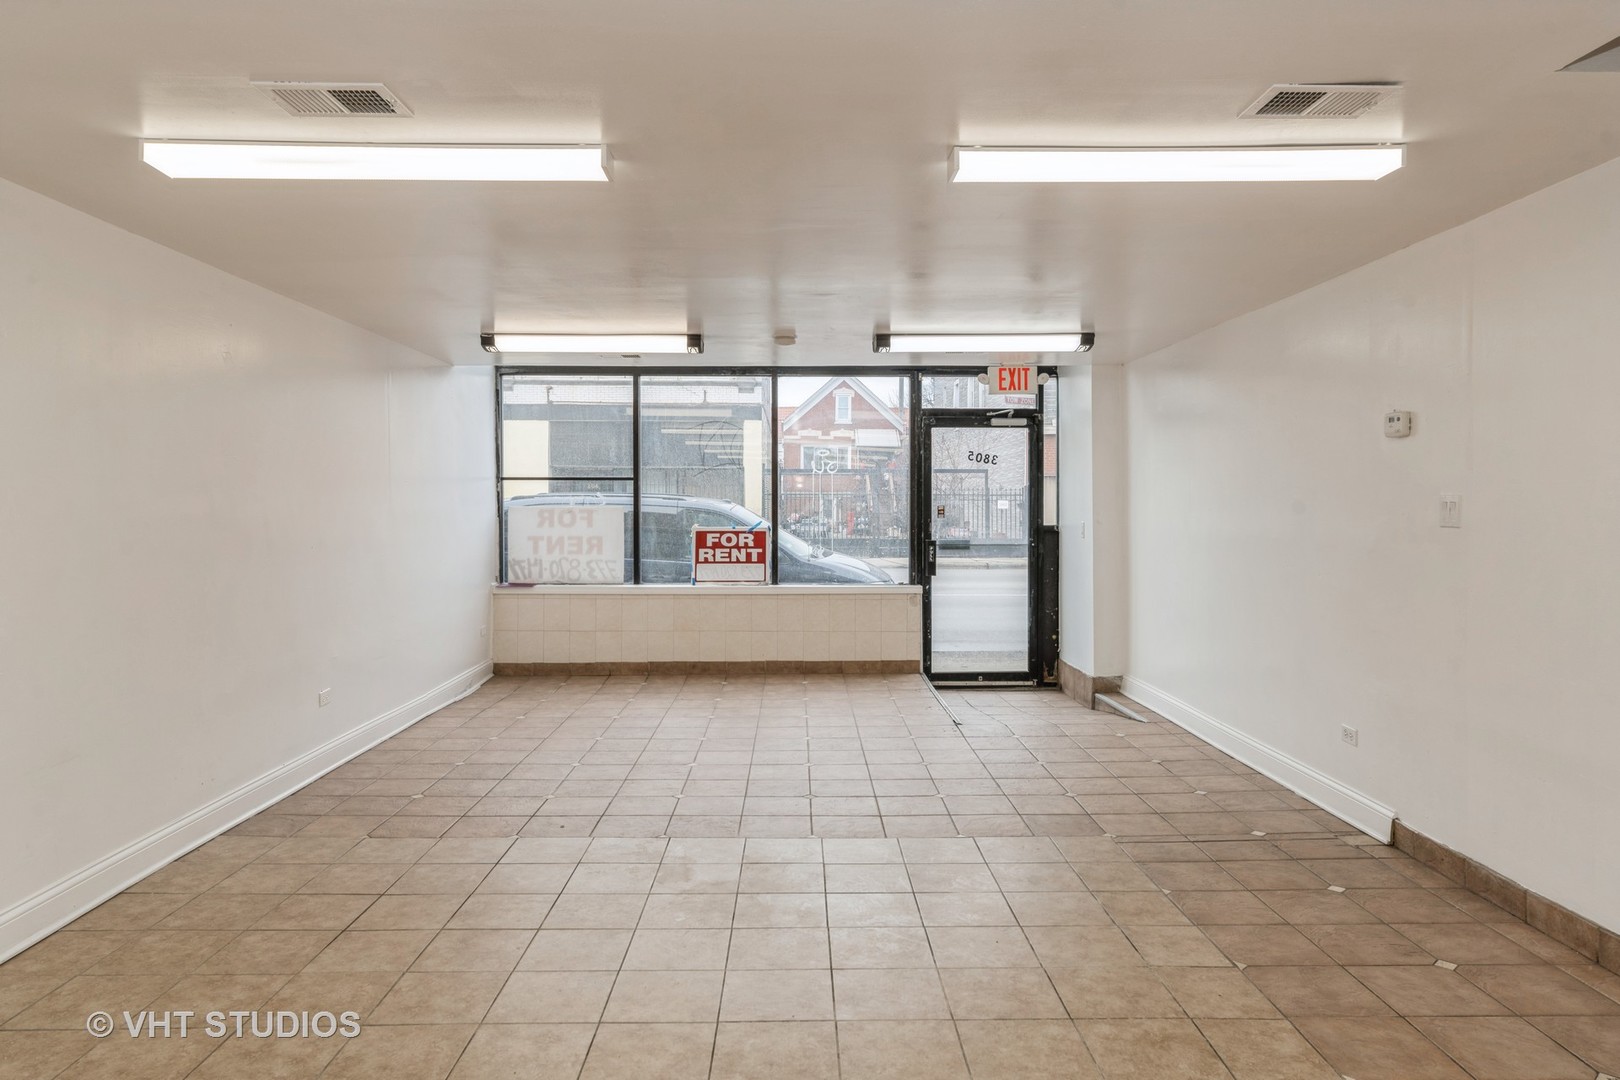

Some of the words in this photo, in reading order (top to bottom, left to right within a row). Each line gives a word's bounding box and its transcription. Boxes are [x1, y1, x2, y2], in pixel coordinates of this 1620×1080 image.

[998, 367, 1030, 391] EXIT
[706, 533, 754, 547] FOR
[698, 548, 763, 562] RENT
